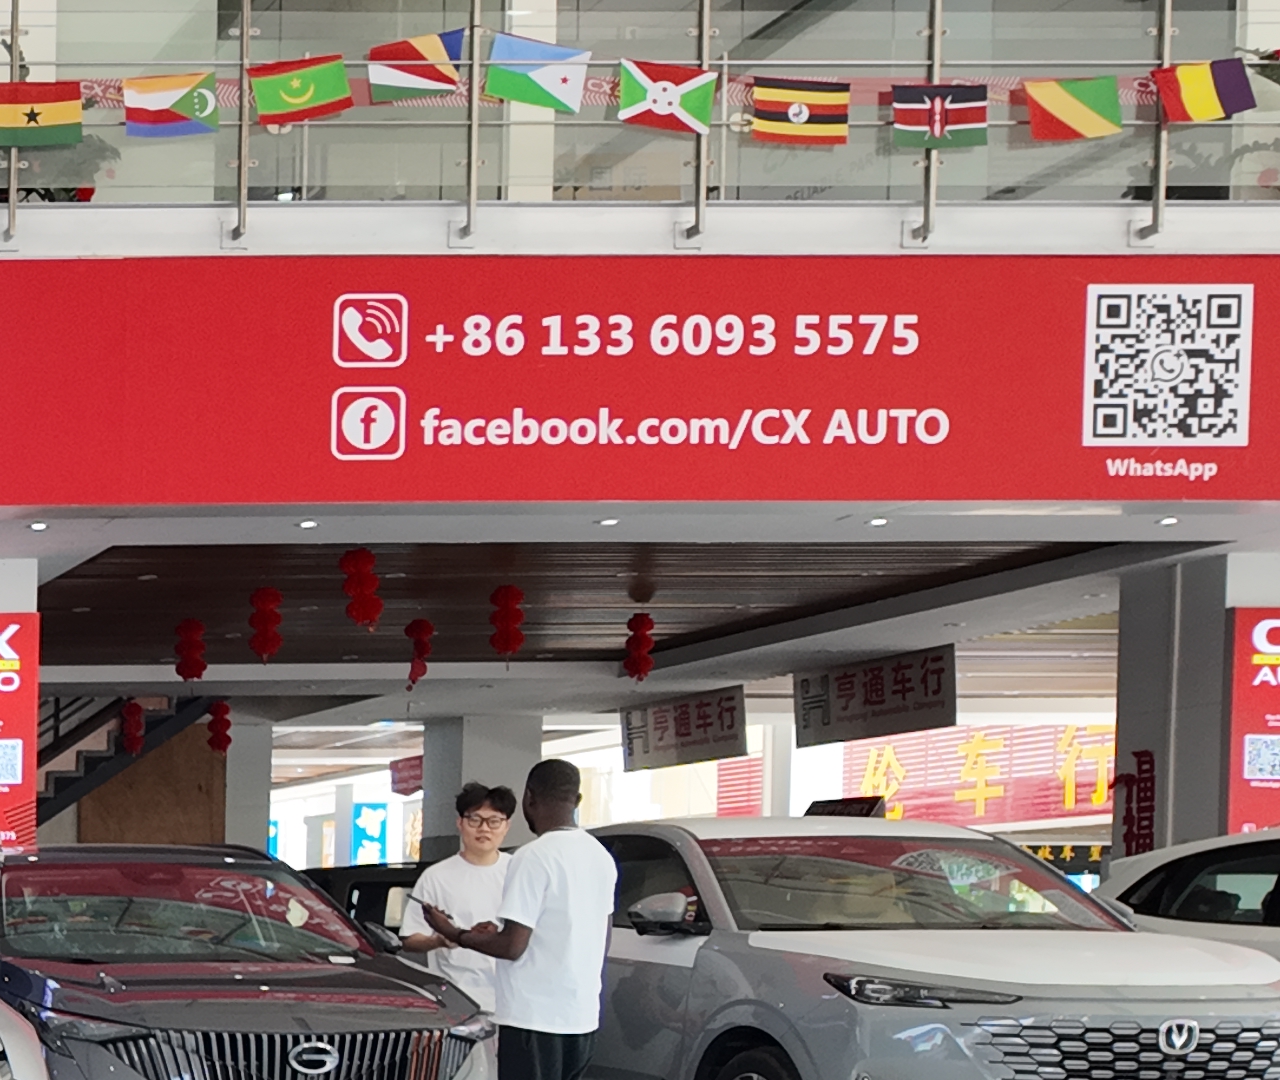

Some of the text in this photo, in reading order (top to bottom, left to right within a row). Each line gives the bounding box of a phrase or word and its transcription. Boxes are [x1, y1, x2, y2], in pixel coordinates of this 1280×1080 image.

[588, 79, 611, 93] CX
[425, 313, 921, 356] +86 133 6093 5575
[420, 407, 951, 449] facebook.com/CX AUTO
[1106, 458, 1218, 482] WhatsApp
[834, 655, 946, 712] 亨通车行
[652, 696, 737, 742] 亨通车行
